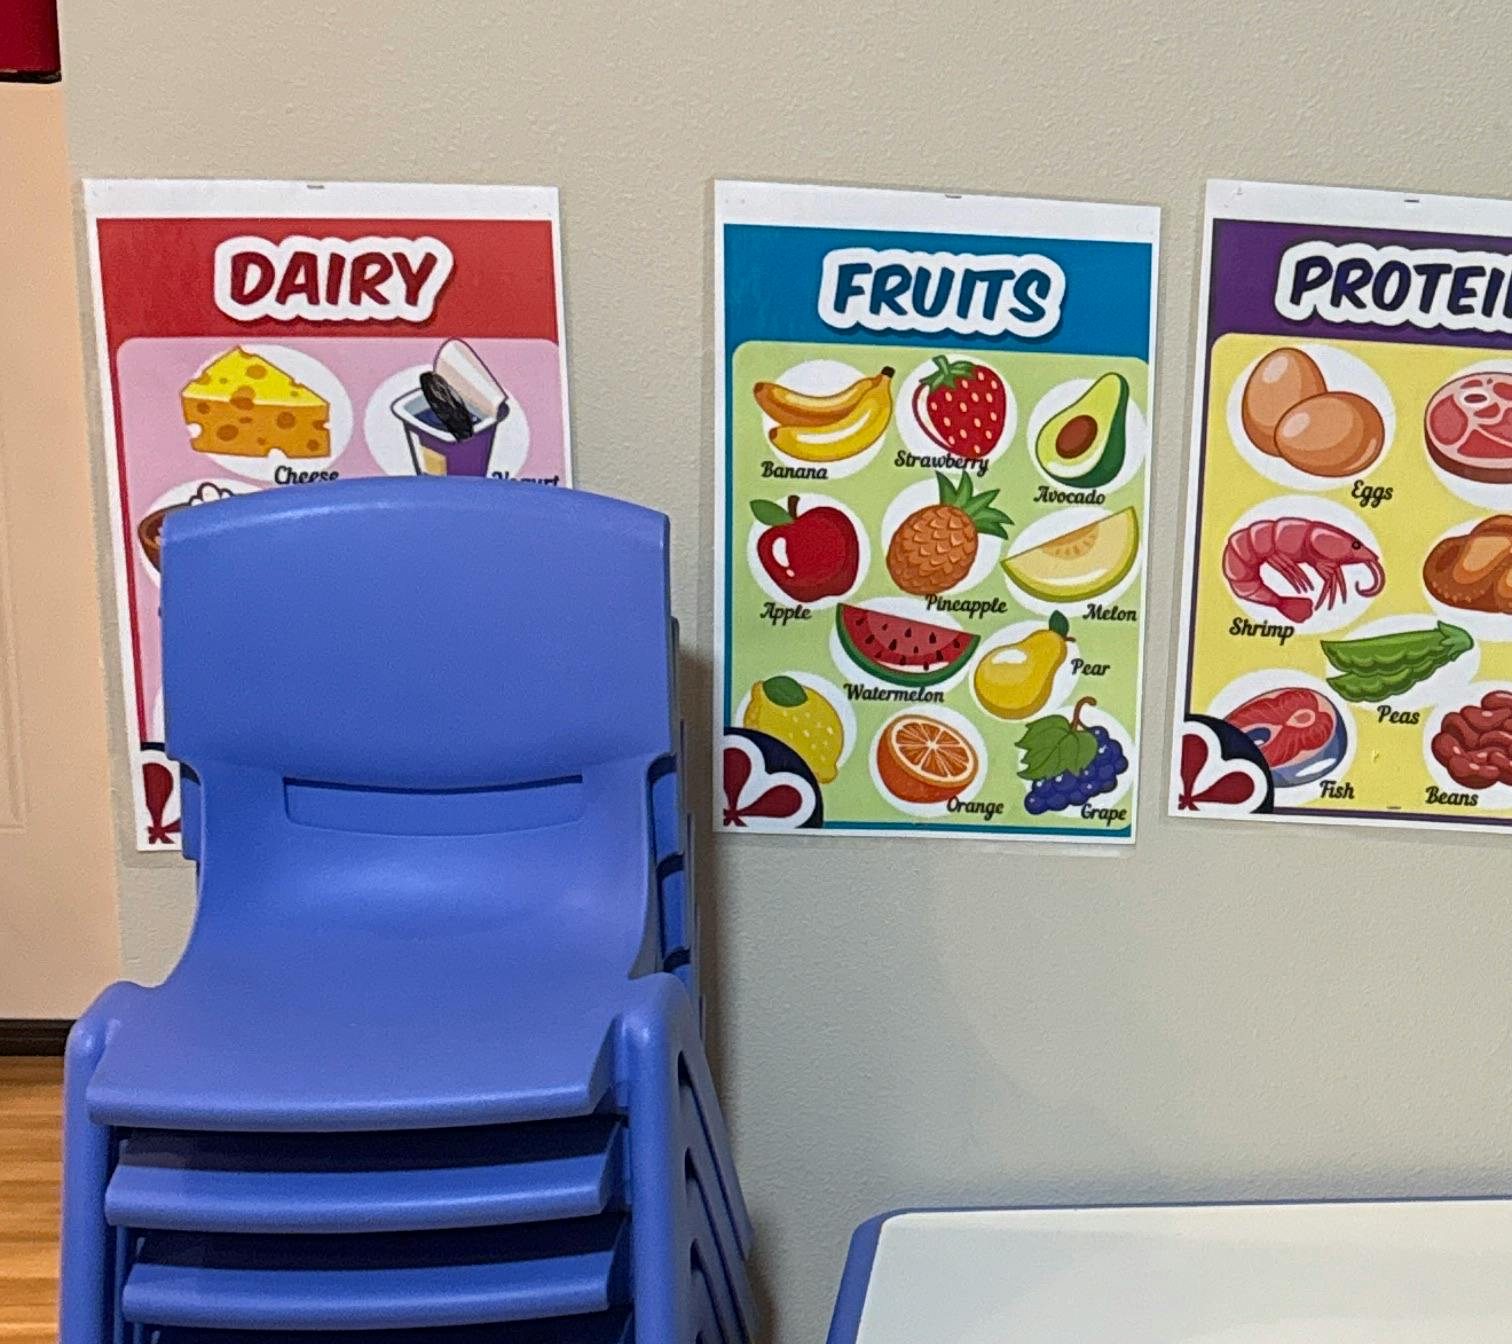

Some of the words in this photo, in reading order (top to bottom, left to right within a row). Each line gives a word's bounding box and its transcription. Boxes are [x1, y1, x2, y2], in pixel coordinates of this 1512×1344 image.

[230, 251, 435, 304] DAIRY
[833, 263, 1049, 321] FRUITS
[761, 461, 826, 479] Banana
[894, 450, 988, 475] Strawberry
[1033, 486, 1104, 505] Avocado
[1351, 481, 1392, 505] Eggs
[760, 603, 810, 624] Apple
[924, 595, 1005, 616] Pineapple
[1082, 604, 1135, 621] Melon
[1229, 618, 1293, 641] Shrimp
[1071, 659, 1108, 676] Pear
[843, 684, 942, 702] Watermelon
[1377, 705, 1419, 725] Peas
[1319, 780, 1353, 798] Fish
[1425, 786, 1476, 806] Beans
[946, 797, 1003, 818] Orange
[1080, 803, 1125, 822] Grape
